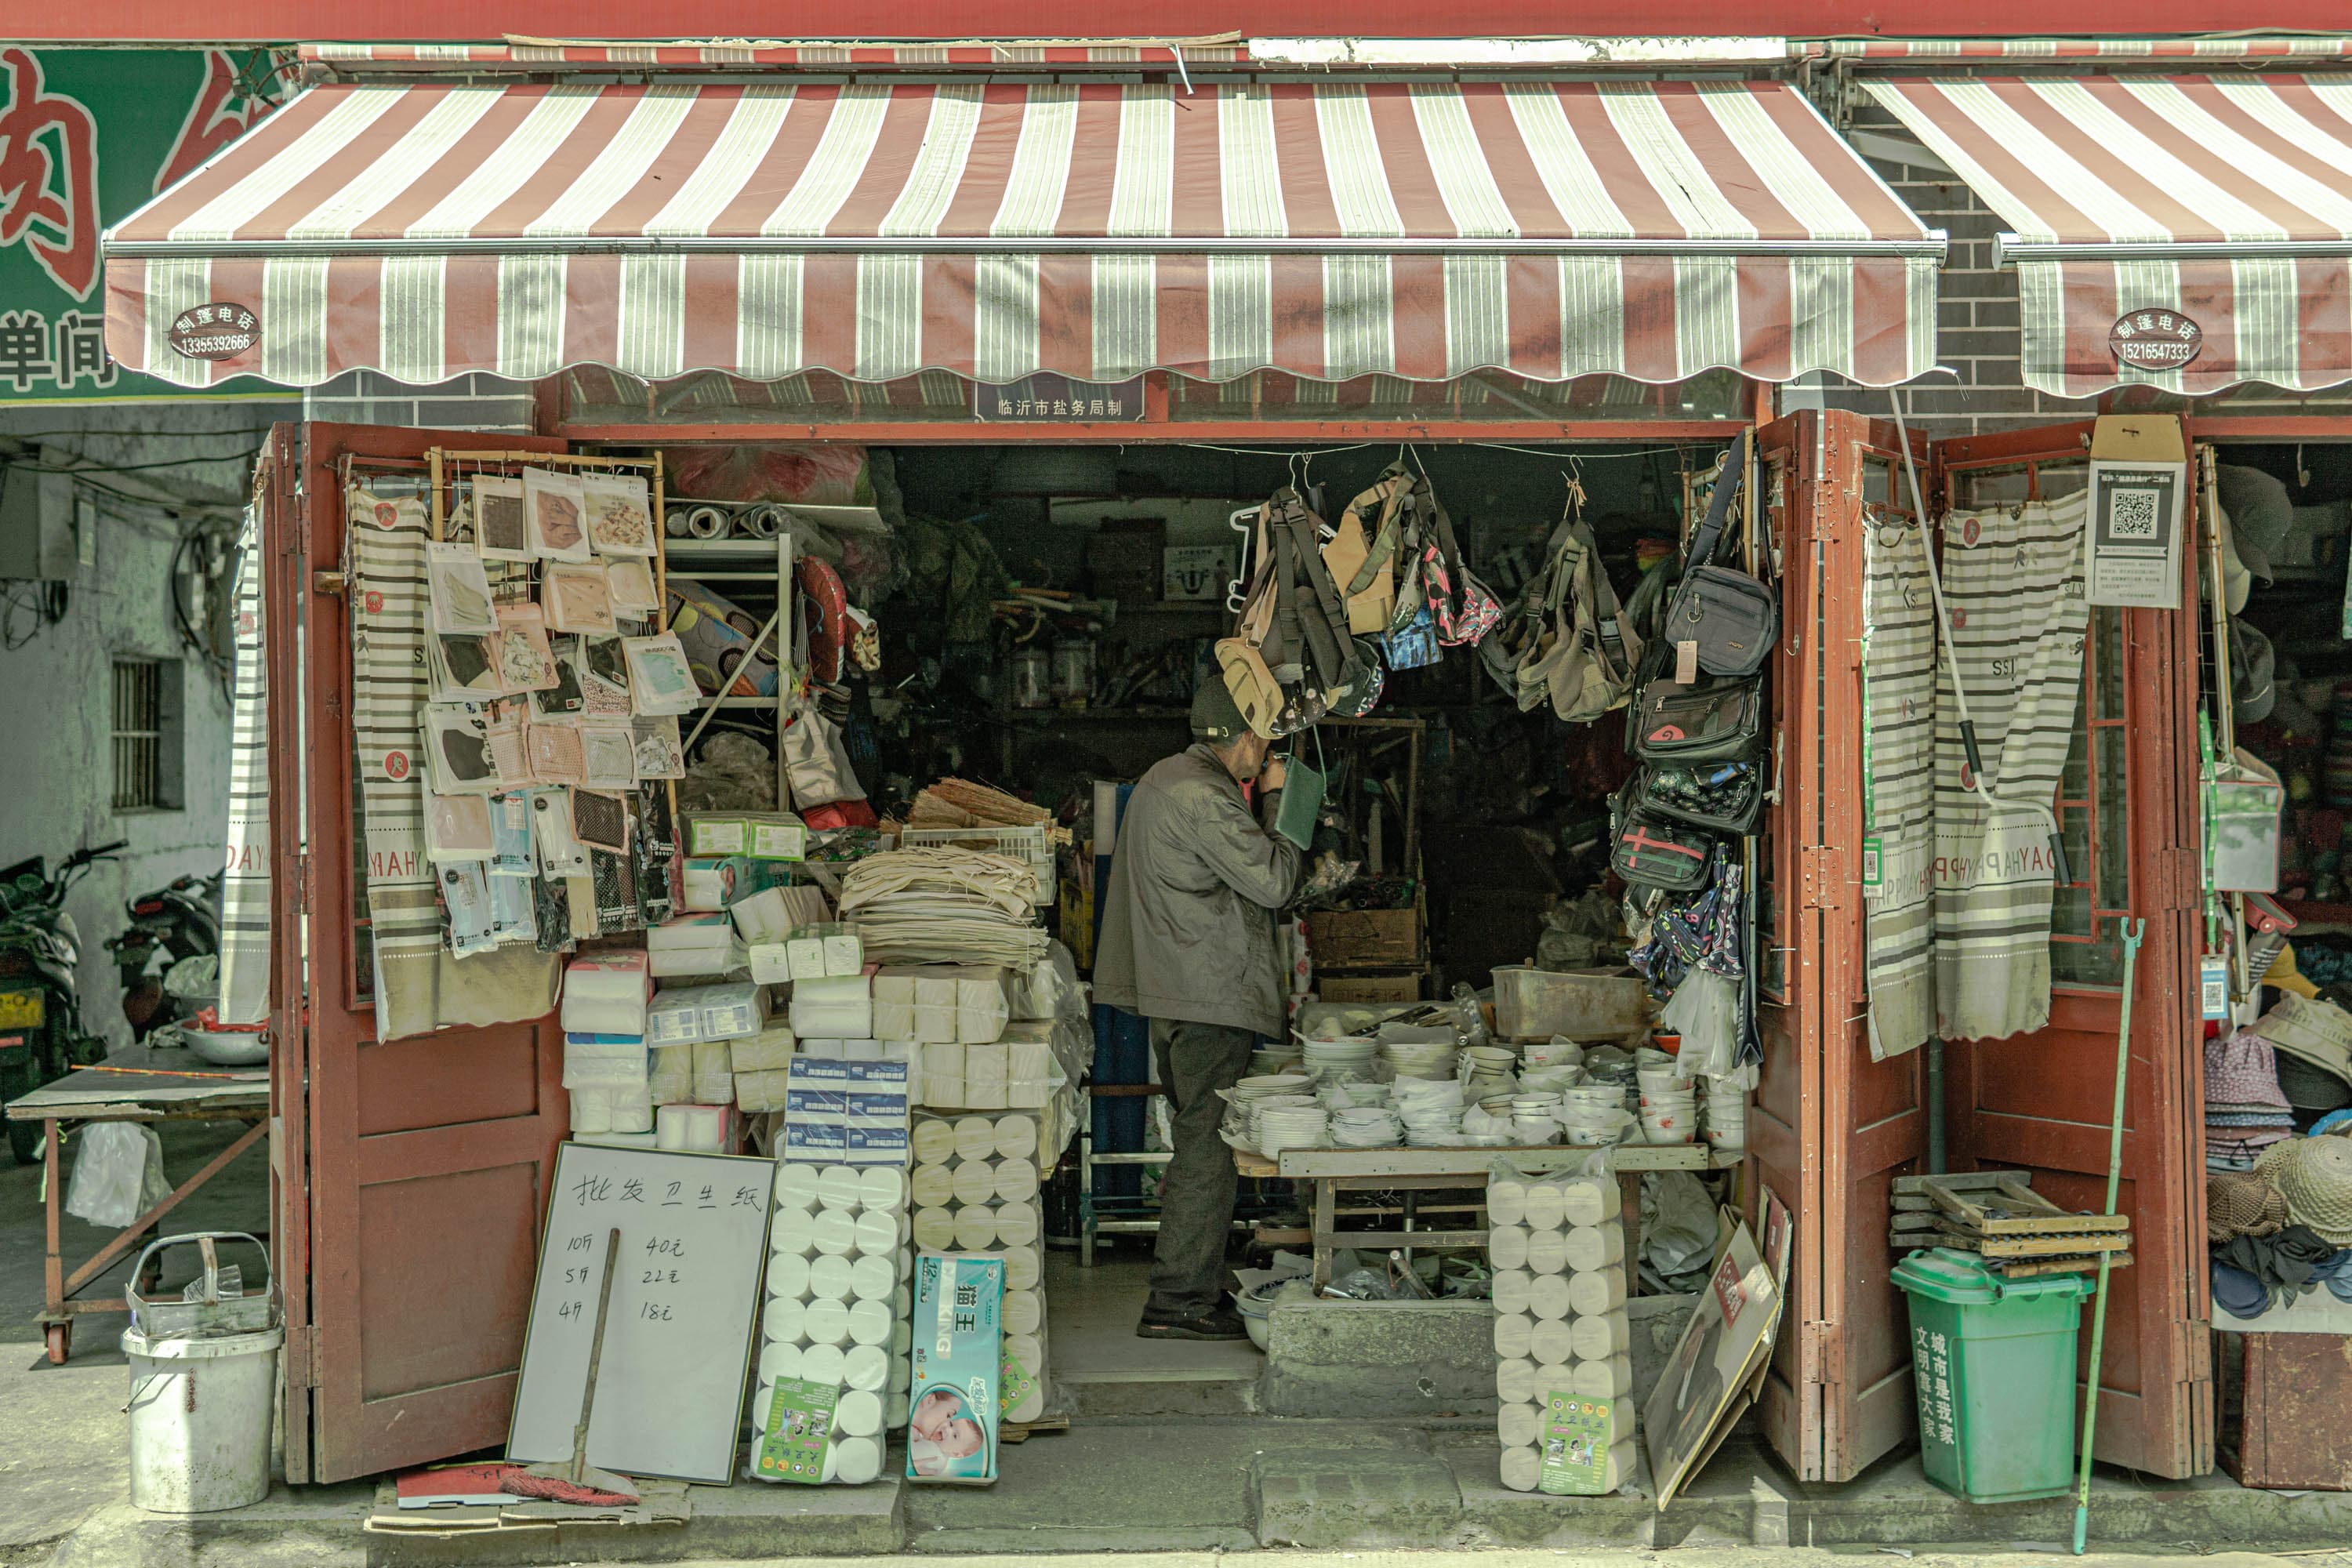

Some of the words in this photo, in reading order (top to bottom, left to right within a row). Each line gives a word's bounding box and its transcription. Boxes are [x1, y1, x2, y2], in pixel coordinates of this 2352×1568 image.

[176, 307, 255, 334] 制篷电话
[2117, 314, 2196, 340] 制篷电话
[181, 334, 250, 354] 13355392666
[2122, 343, 2190, 359] 15216547333
[998, 399, 1122, 416] 临沂市盐务局制
[572, 1174, 762, 1213] 批发卫生纸
[567, 1234, 593, 1253] 10斤
[646, 1236, 684, 1258] 40元
[564, 1266, 589, 1284] 5斤
[927, 1261, 938, 1279] 12
[558, 1301, 582, 1323] 4斤
[640, 1301, 673, 1321] 18元
[955, 1283, 977, 1332] 猫王
[936, 1304, 953, 1353] KING
[1916, 1326, 1936, 1438] 文明靠大家
[1931, 1332, 1955, 1445] 城市是我家
